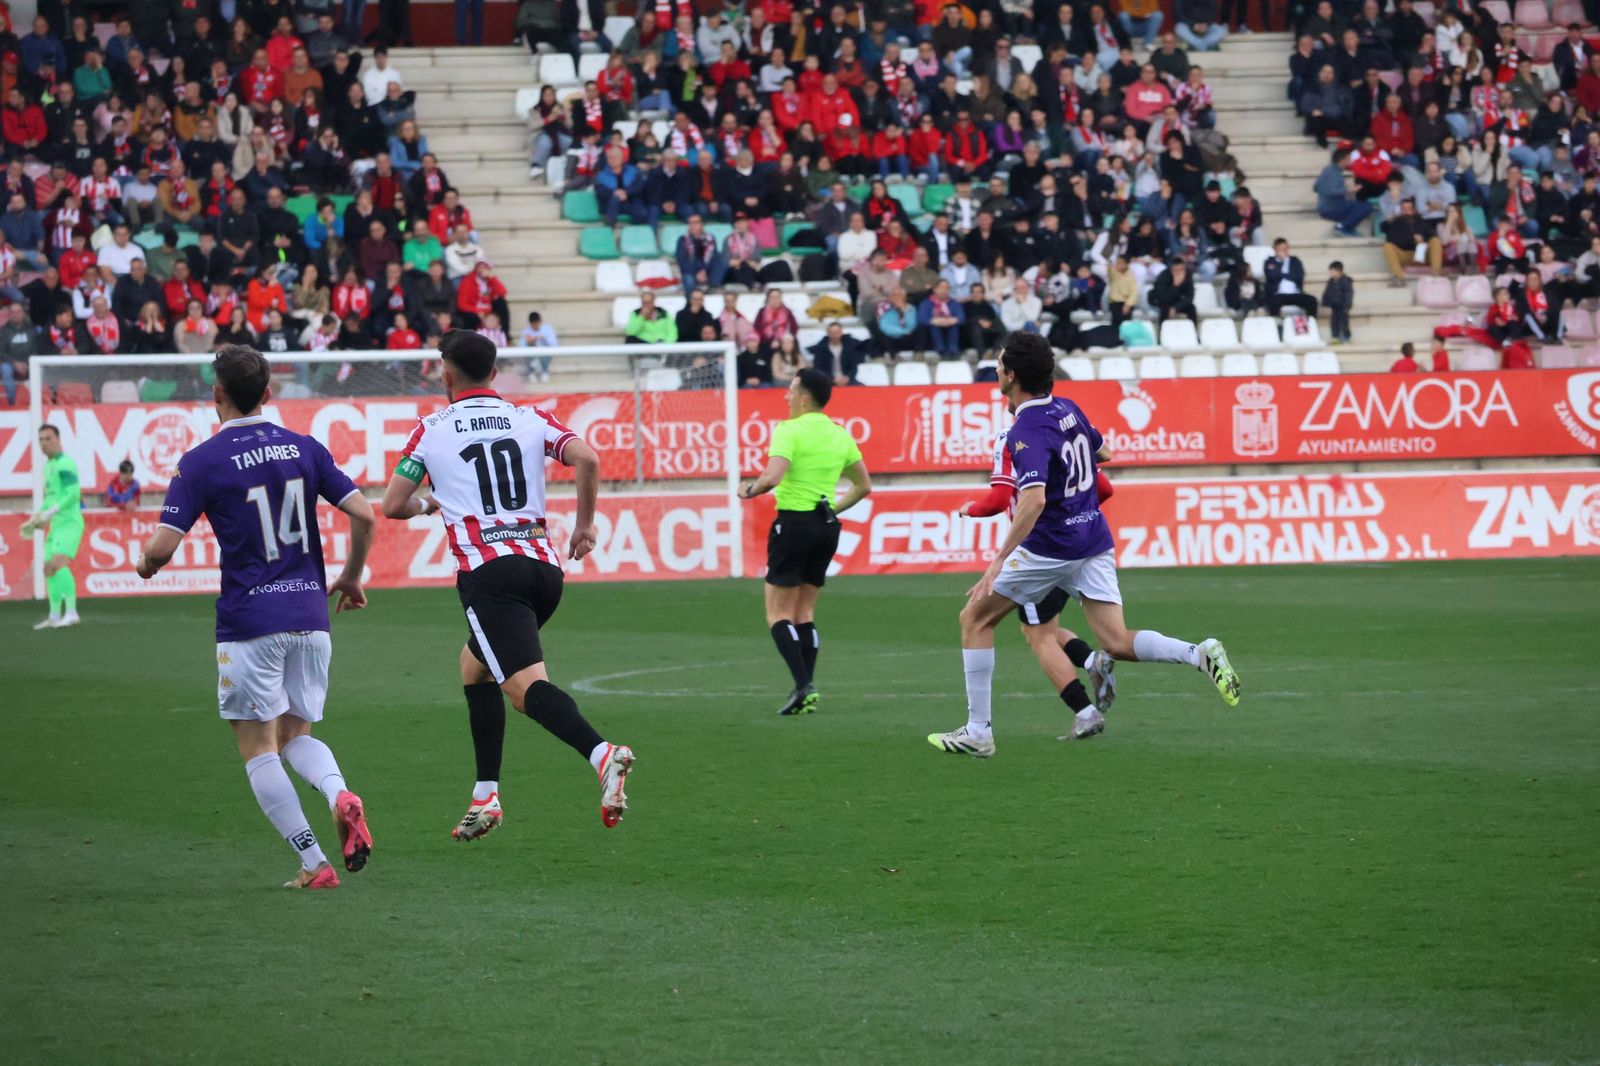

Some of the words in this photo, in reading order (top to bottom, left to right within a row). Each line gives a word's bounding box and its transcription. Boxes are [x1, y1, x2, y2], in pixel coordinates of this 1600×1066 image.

[455, 420, 468, 433] C.
[470, 416, 511, 431] RAMOS
[1299, 378, 1519, 431] ZAMORA
[1553, 400, 1597, 449] ZAMORA
[231, 444, 301, 471] TAVARES
[588, 420, 727, 452] CENTRO
[1298, 436, 1437, 455] AYUNTAMIENTO
[458, 438, 528, 516] 10
[1061, 433, 1094, 498] 20
[246, 477, 310, 564] 14
[1118, 519, 1391, 569] ZAMORANAS
[1395, 533, 1449, 561] S.L.
[294, 830, 316, 849] FS
